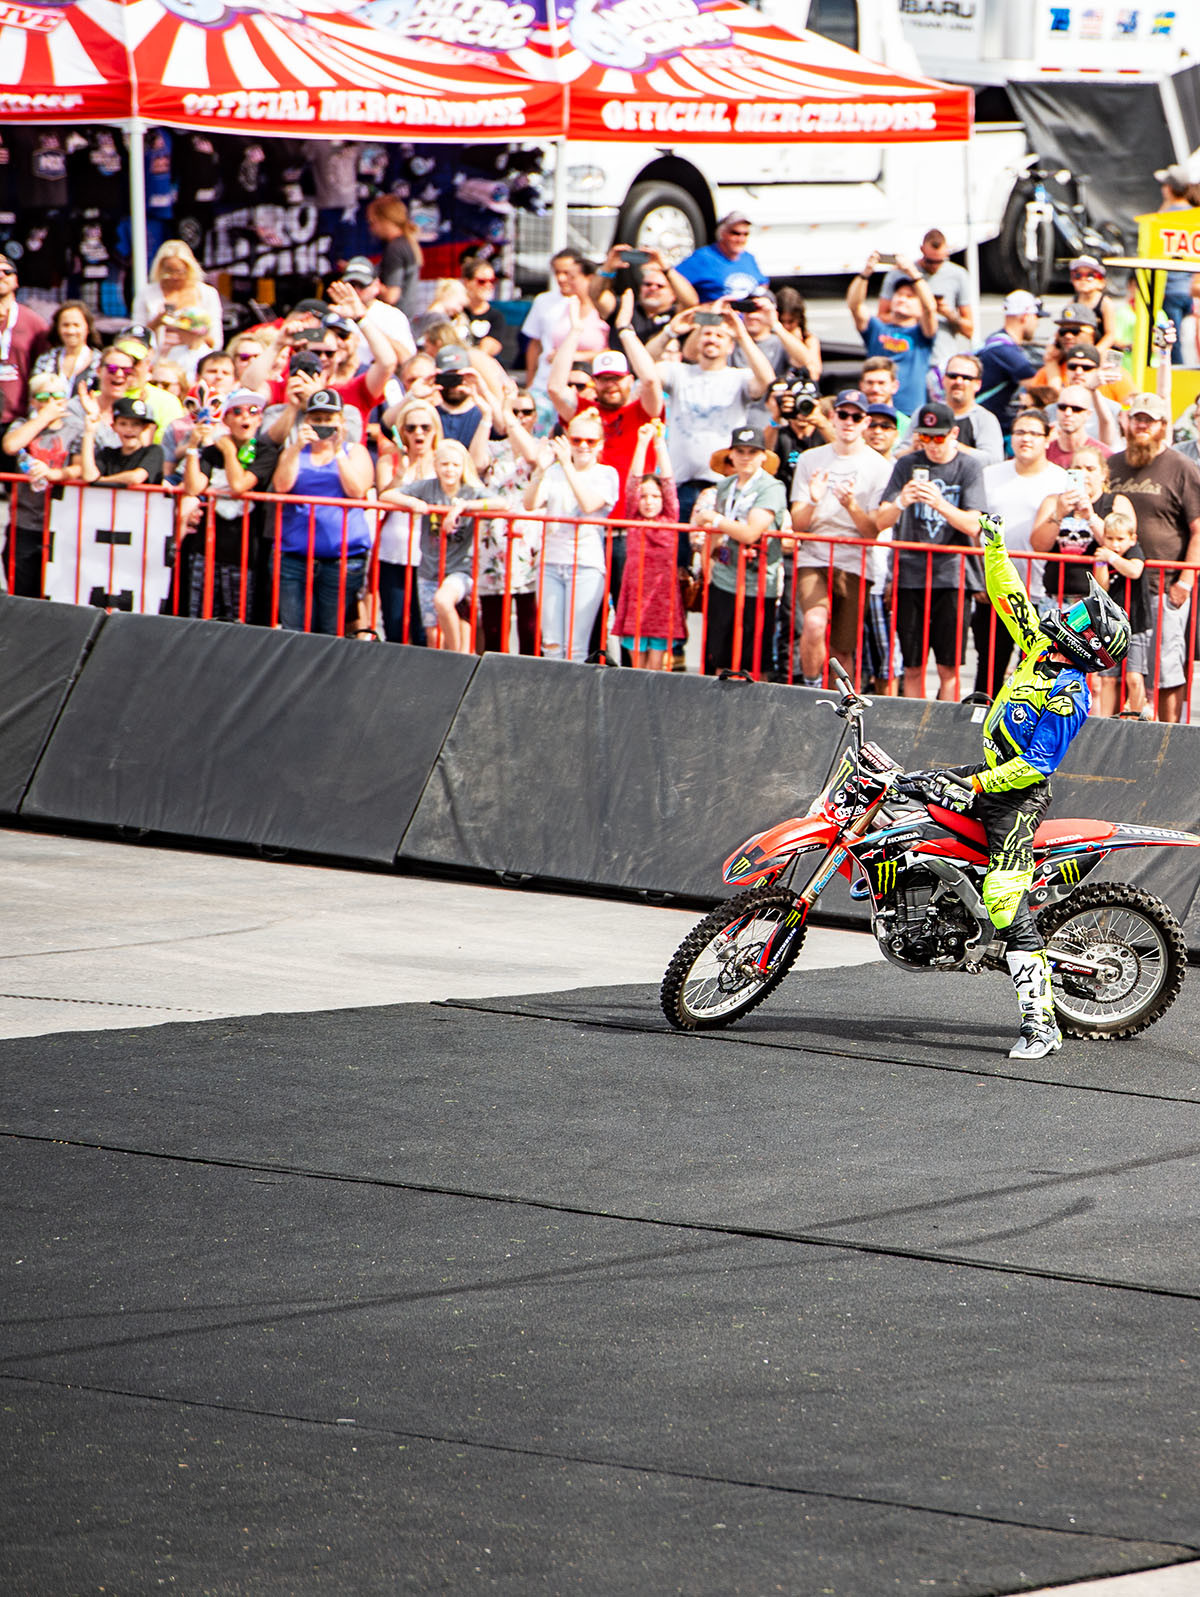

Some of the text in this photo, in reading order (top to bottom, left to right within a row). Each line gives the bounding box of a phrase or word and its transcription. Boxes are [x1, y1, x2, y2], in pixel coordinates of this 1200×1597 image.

[182, 90, 526, 127] OFFICIAL MERCHANDISE
[601, 100, 937, 133] OFFICIAL MERCHANDISE
[1065, 635, 1092, 659] MONSTER
[887, 831, 921, 845] HONDA
[1045, 834, 1084, 846] HONDA
[813, 866, 837, 895] Factory
[773, 927, 797, 961] MICHELIN
[1060, 961, 1094, 976] RENTHAL
